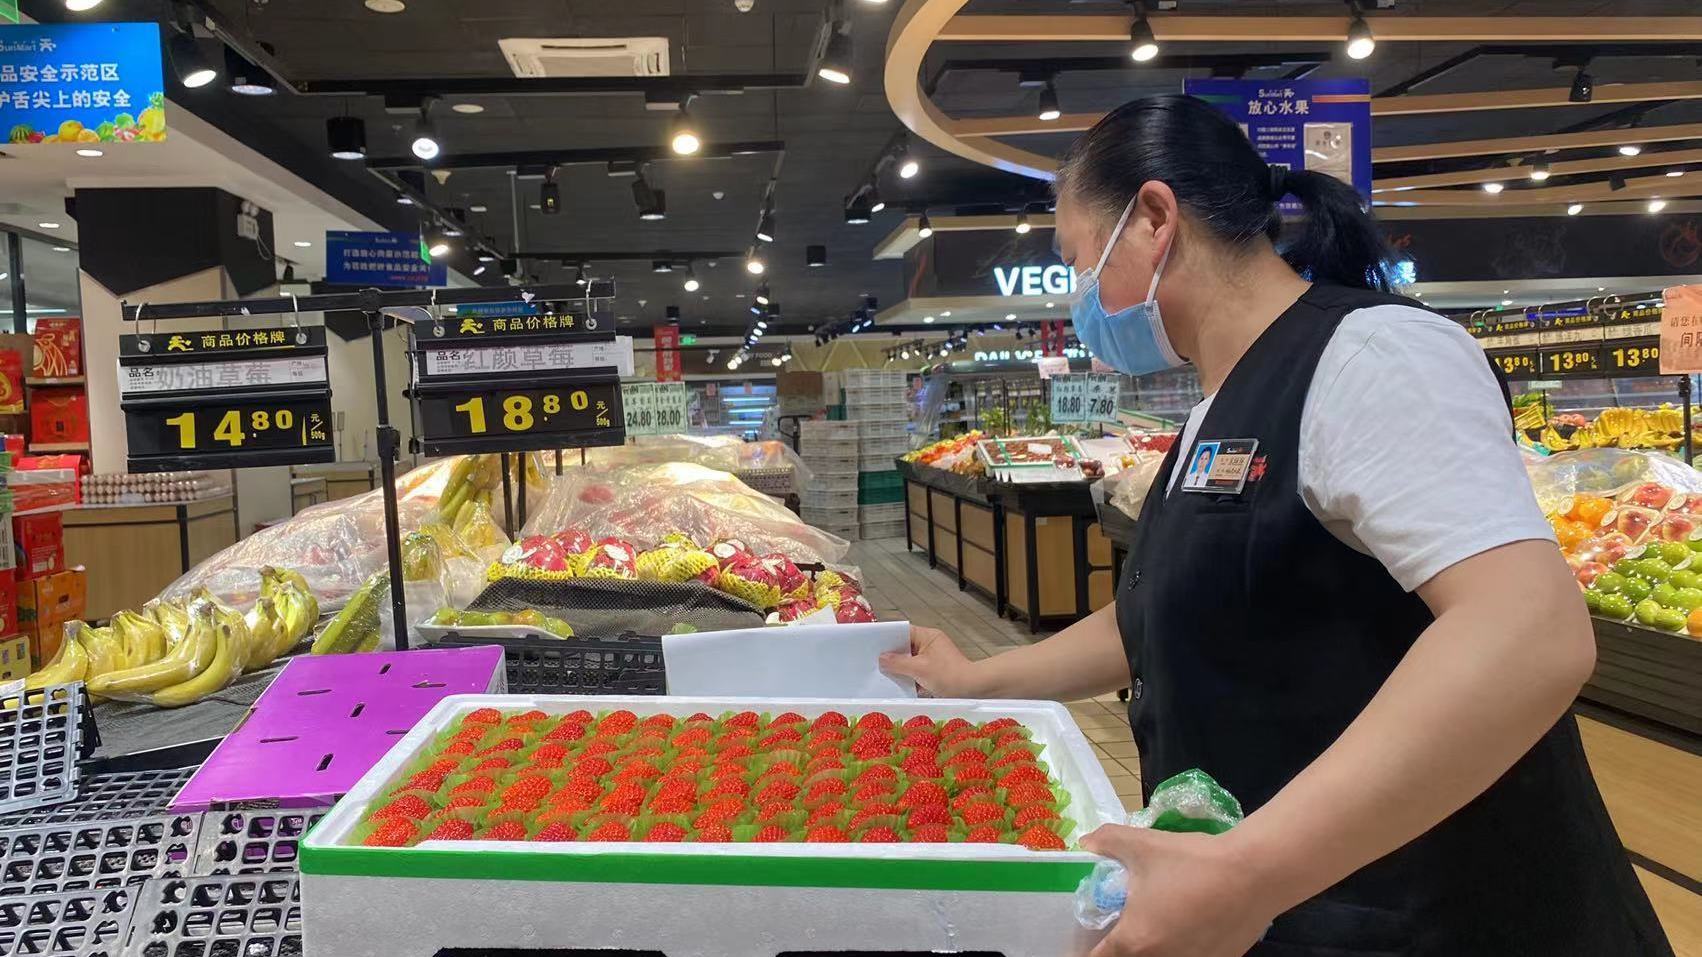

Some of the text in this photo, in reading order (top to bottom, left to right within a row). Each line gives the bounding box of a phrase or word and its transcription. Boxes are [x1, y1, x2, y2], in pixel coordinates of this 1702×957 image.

[1, 63, 120, 82] 品安全示范区
[1248, 99, 1310, 115] 放心水果
[493, 315, 575, 332] 商品价格牌
[201, 331, 286, 348] 商品价格牌
[159, 361, 273, 389] 奶油草莓
[455, 390, 589, 433] 18.80
[1058, 396, 1081, 413] 18.80
[1090, 398, 1114, 415] 7.80
[166, 409, 294, 449] 14.80
